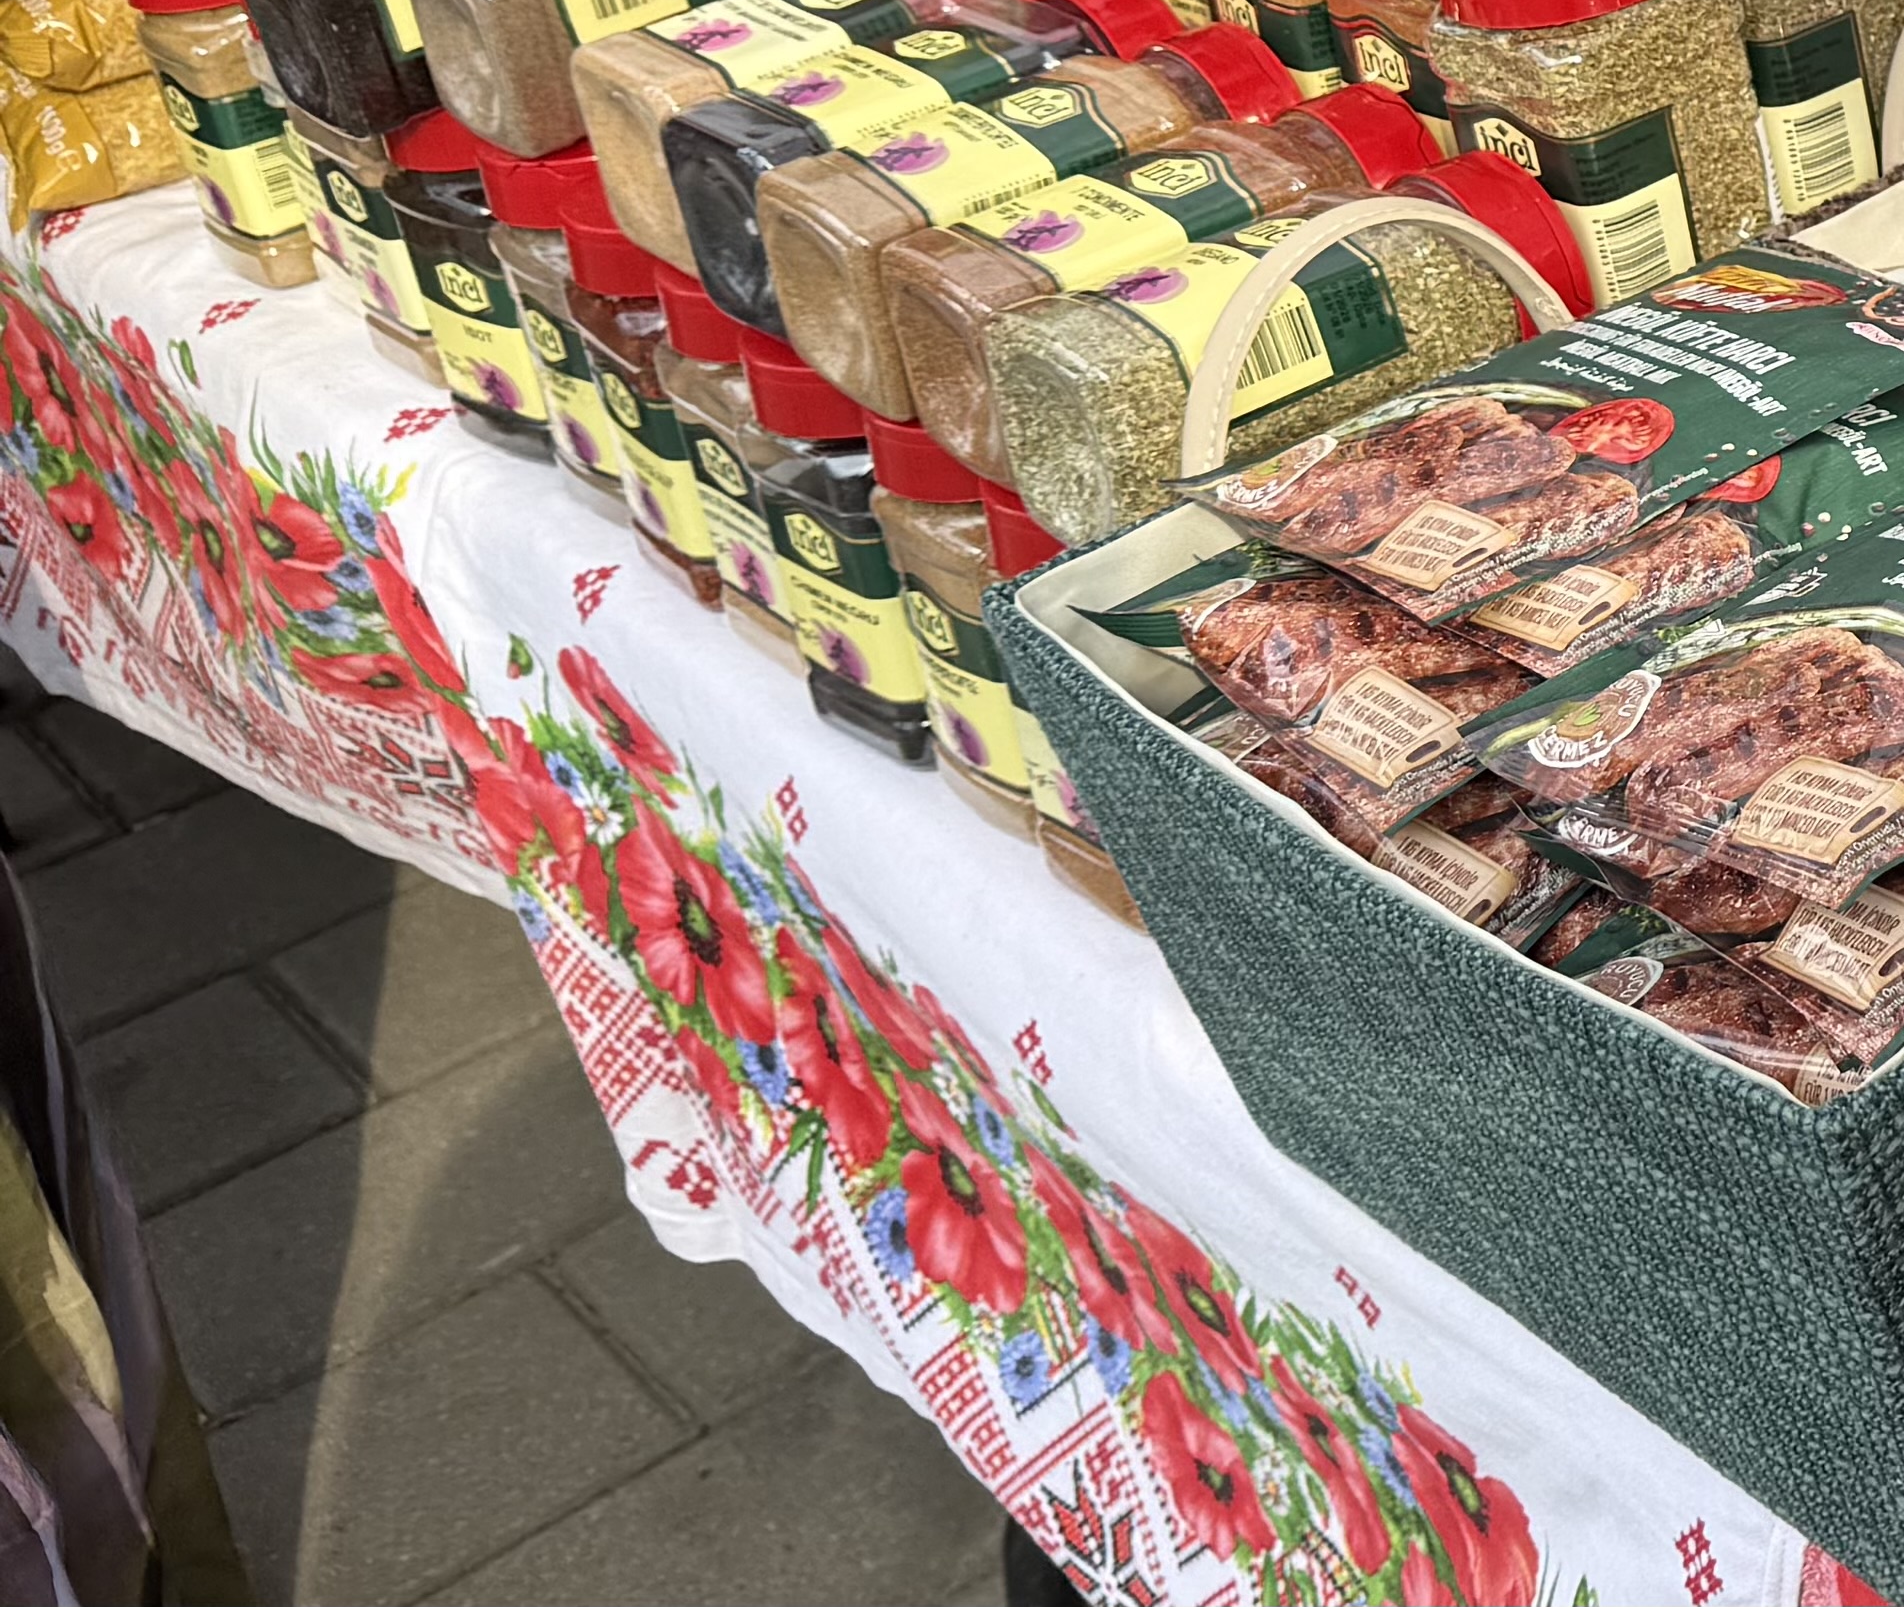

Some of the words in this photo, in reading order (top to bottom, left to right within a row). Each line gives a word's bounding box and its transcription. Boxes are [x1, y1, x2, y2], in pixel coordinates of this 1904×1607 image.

[1362, 45, 1404, 88] inci
[1011, 89, 1070, 118] inci
[1478, 128, 1538, 170] inci
[1143, 163, 1204, 191] inci
